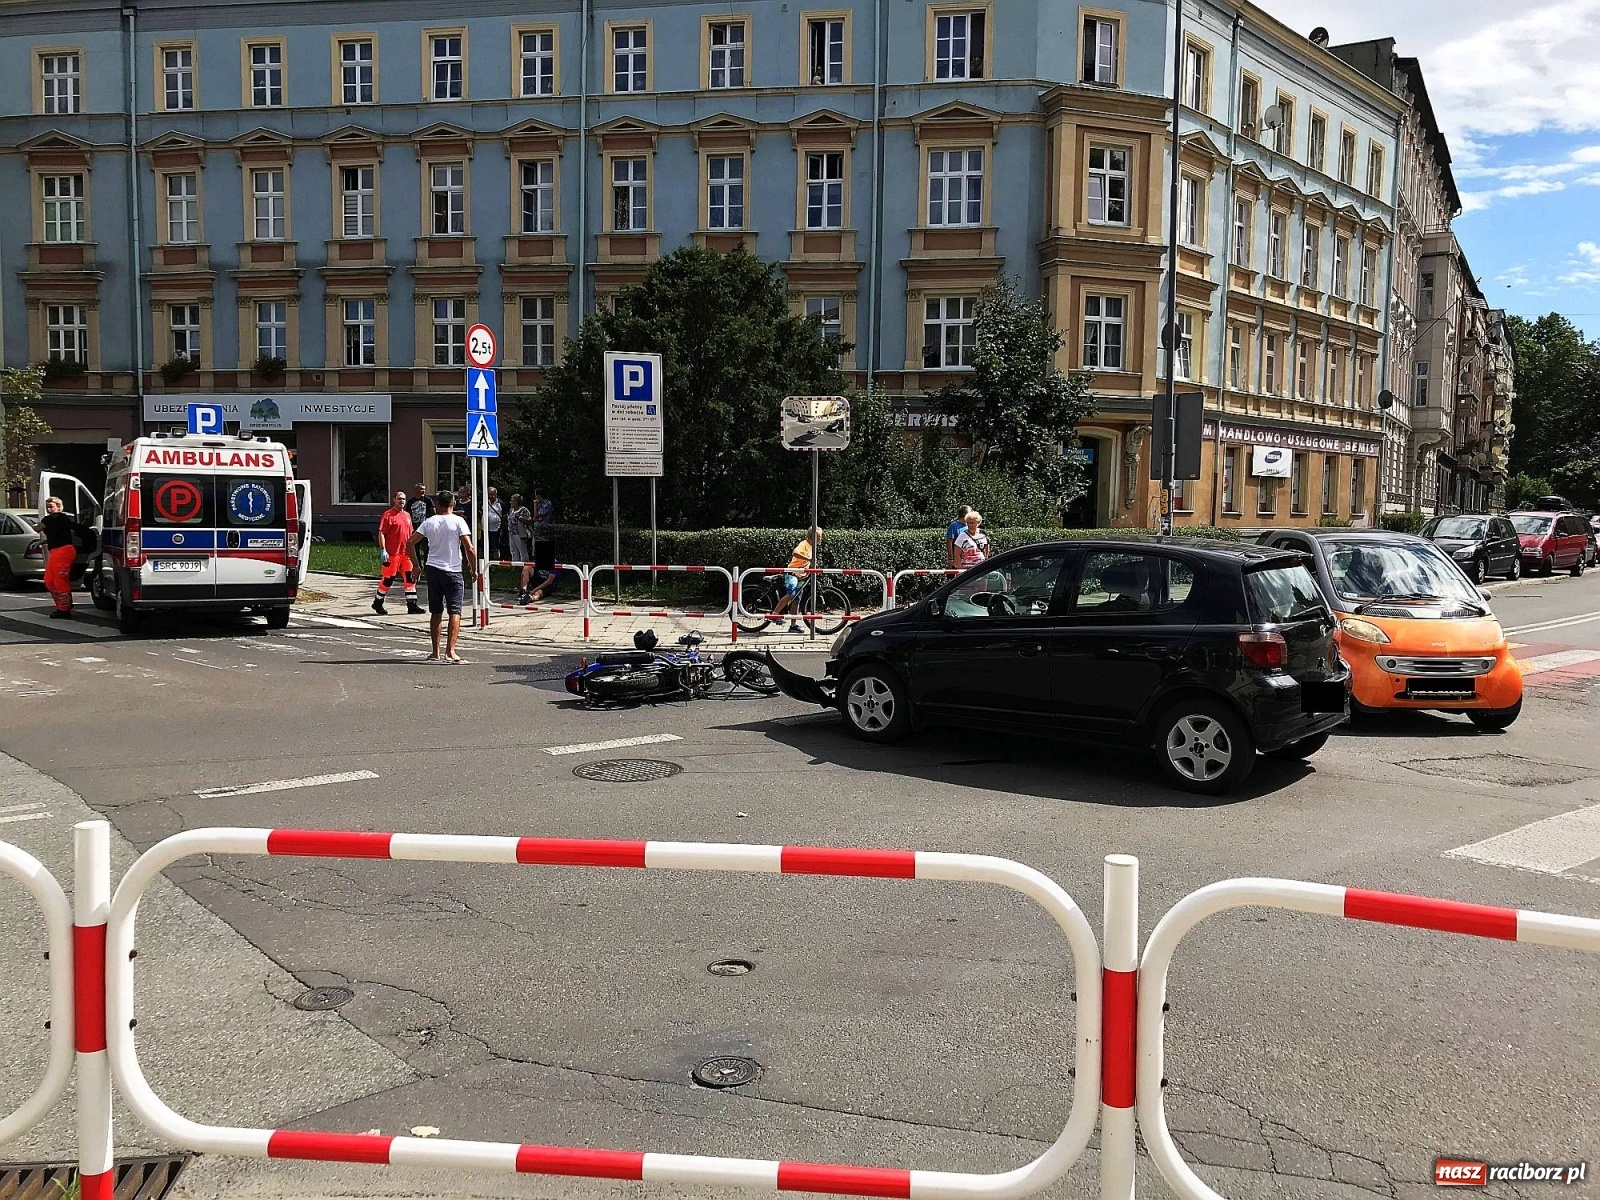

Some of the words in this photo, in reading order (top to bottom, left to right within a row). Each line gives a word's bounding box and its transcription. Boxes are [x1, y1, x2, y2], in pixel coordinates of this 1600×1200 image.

[471, 337, 492, 356] 2,5t
[622, 364, 645, 396] P
[300, 404, 376, 413] INWESTYCJE
[195, 407, 217, 434] P
[144, 449, 275, 468] AMBULANS
[160, 562, 177, 570] SRC
